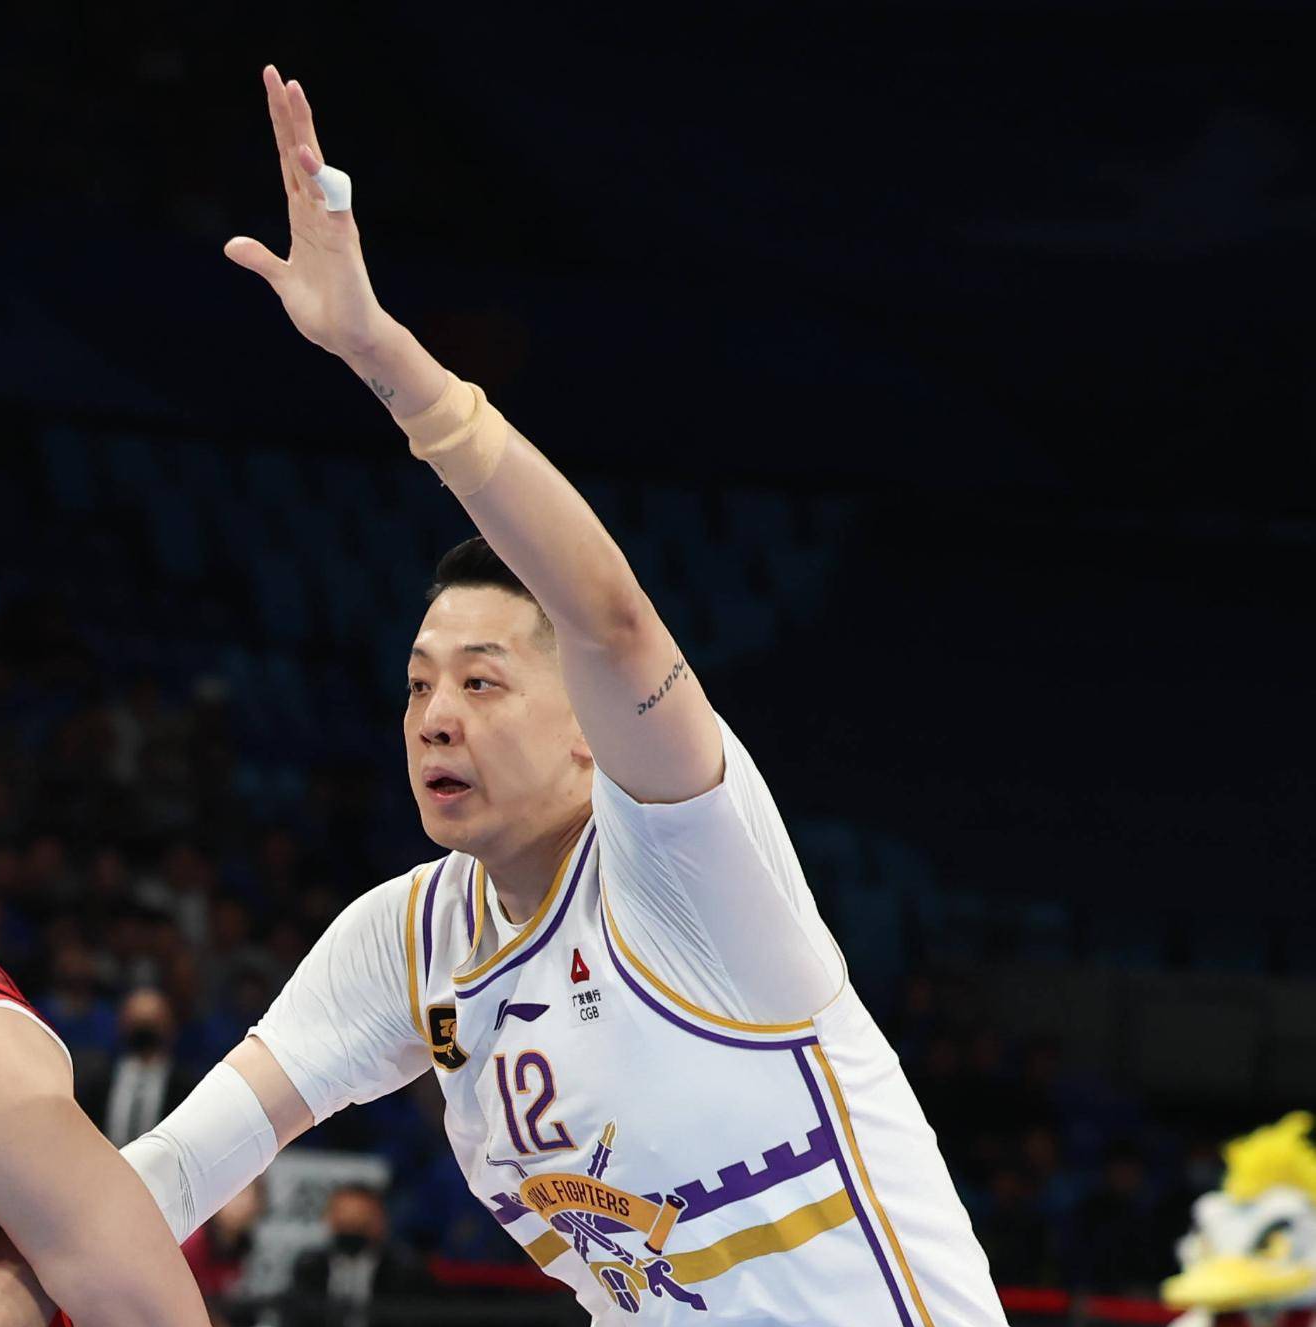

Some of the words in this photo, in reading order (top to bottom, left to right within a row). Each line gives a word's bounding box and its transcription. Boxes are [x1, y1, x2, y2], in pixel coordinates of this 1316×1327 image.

[580, 1006, 599, 1021] CGB
[494, 1049, 578, 1155] 12
[551, 1180, 630, 1217] FIGHTERS
